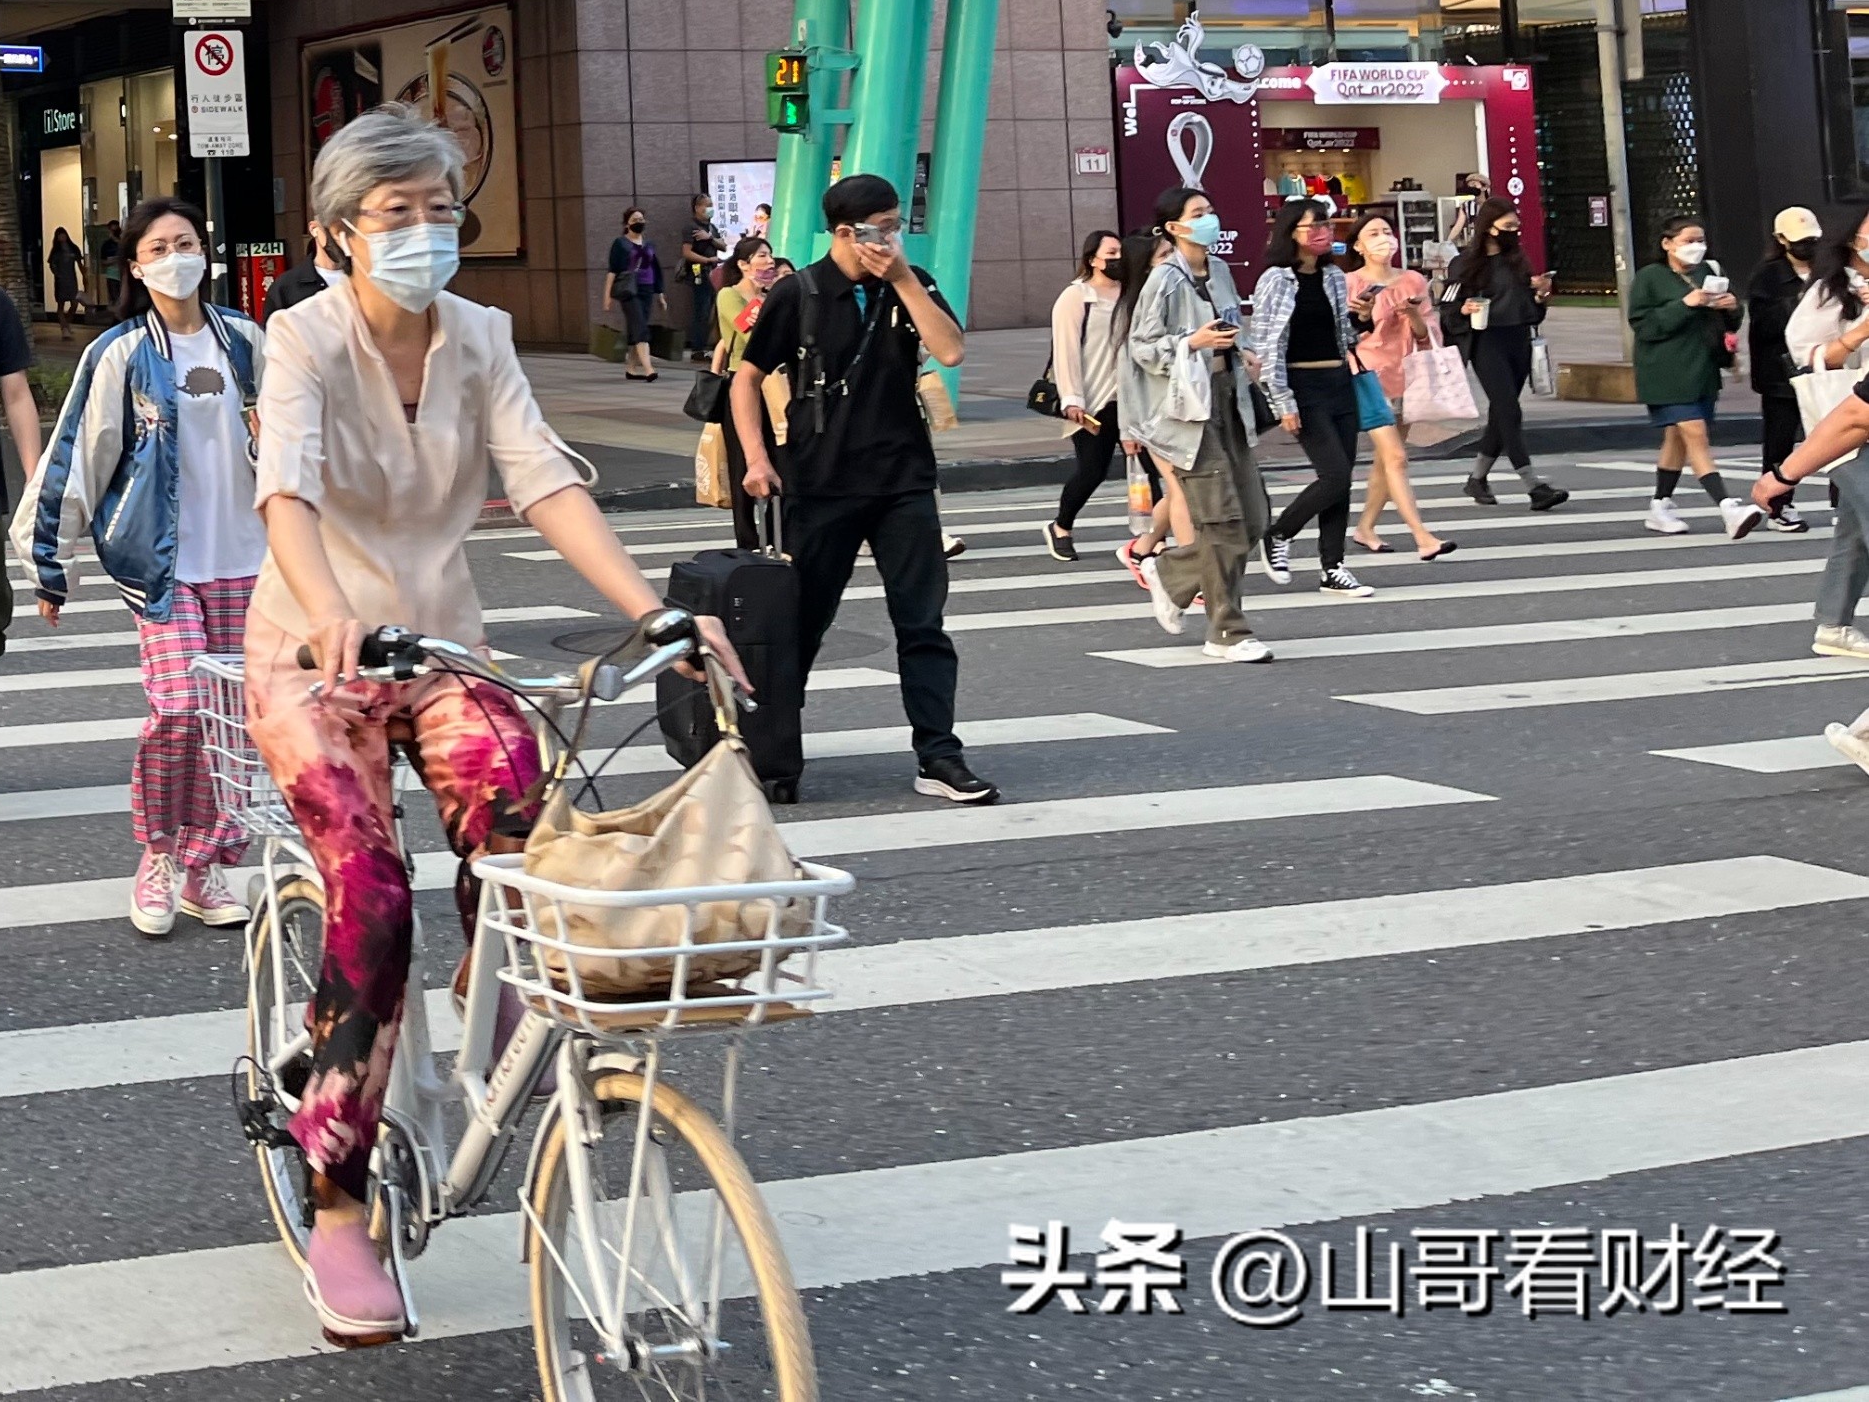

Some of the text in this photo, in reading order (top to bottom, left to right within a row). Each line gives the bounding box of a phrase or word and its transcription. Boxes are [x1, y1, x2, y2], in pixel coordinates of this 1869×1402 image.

[776, 58, 799, 85] 21
[1331, 69, 1430, 80] FIFA WORLD CUP
[191, 93, 243, 103] 行人徒步區
[201, 105, 244, 113] SIDEWALK
[1087, 159, 1100, 170] 11
[1218, 230, 1238, 241] CUP
[253, 243, 281, 255] 24H
